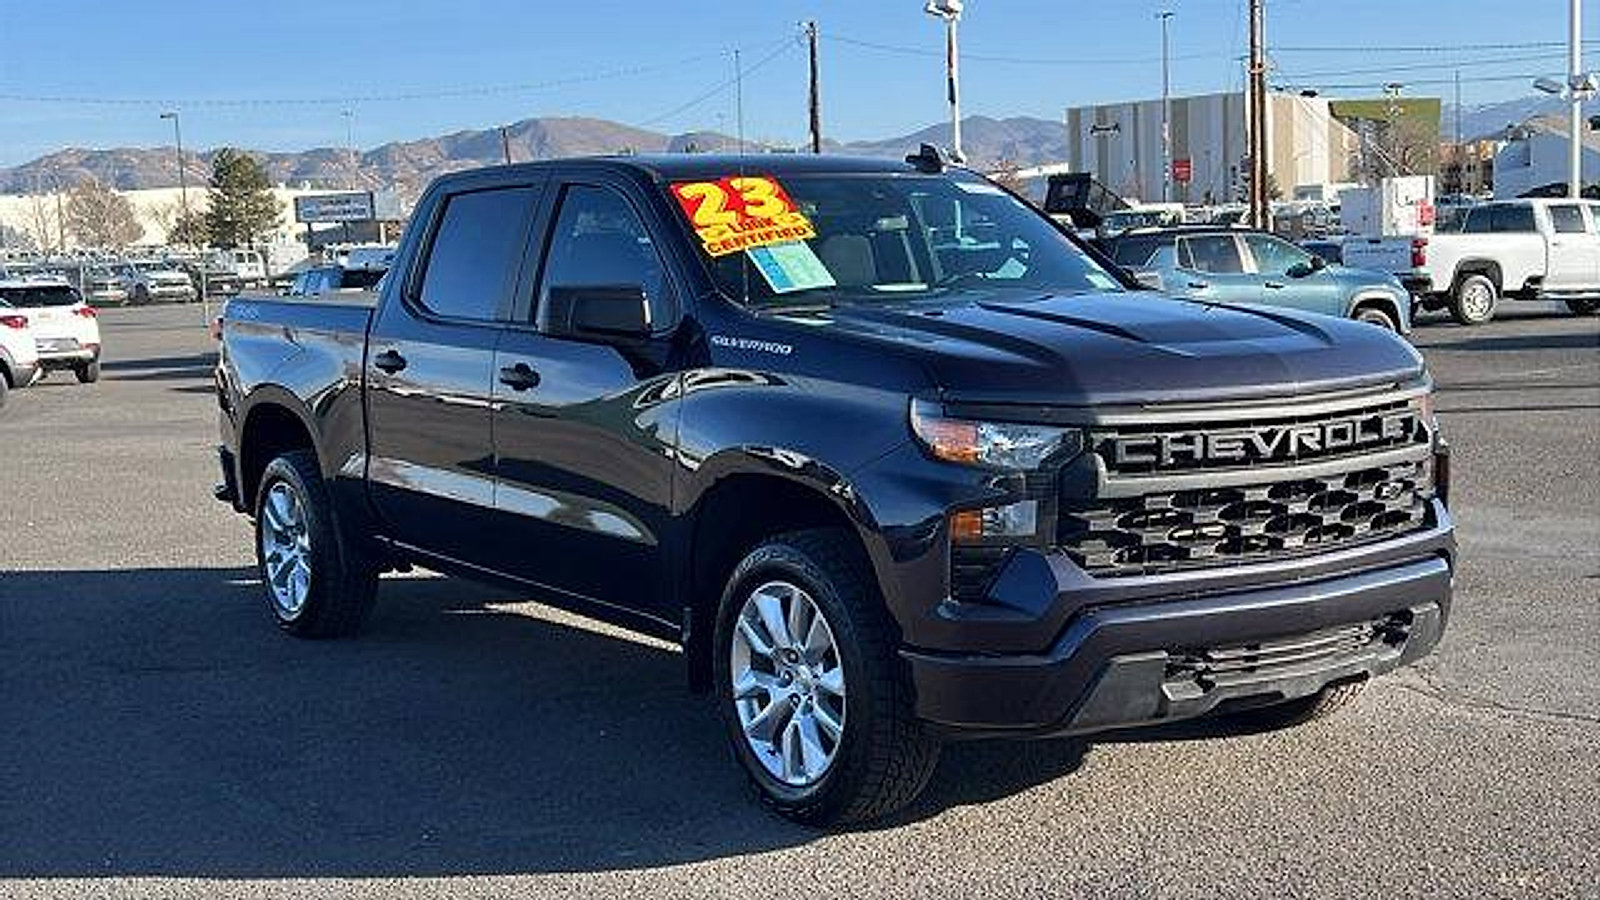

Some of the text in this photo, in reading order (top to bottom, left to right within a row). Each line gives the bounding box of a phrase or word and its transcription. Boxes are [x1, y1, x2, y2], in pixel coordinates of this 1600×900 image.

[678, 177, 787, 226] 23
[707, 227, 809, 254] CERTIFIED
[710, 334, 792, 355] SILVERADO
